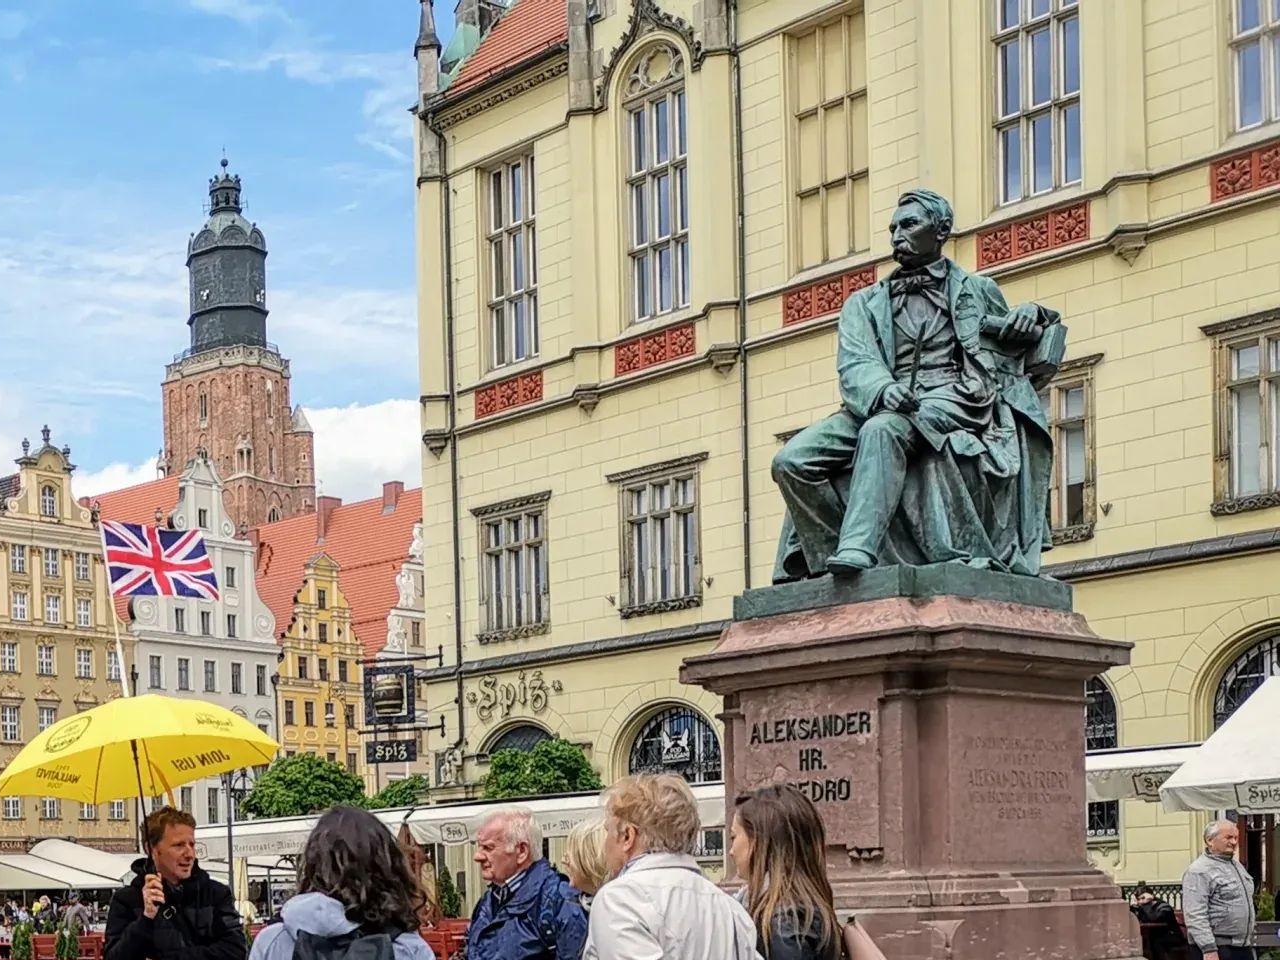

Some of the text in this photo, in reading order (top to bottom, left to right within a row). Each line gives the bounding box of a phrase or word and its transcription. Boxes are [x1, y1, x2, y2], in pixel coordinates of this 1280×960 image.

[750, 711, 871, 745] ALEKSANDER
[799, 749, 827, 771] HR.
[787, 777, 852, 803] EDRO
[1144, 777, 1165, 792] Spi
